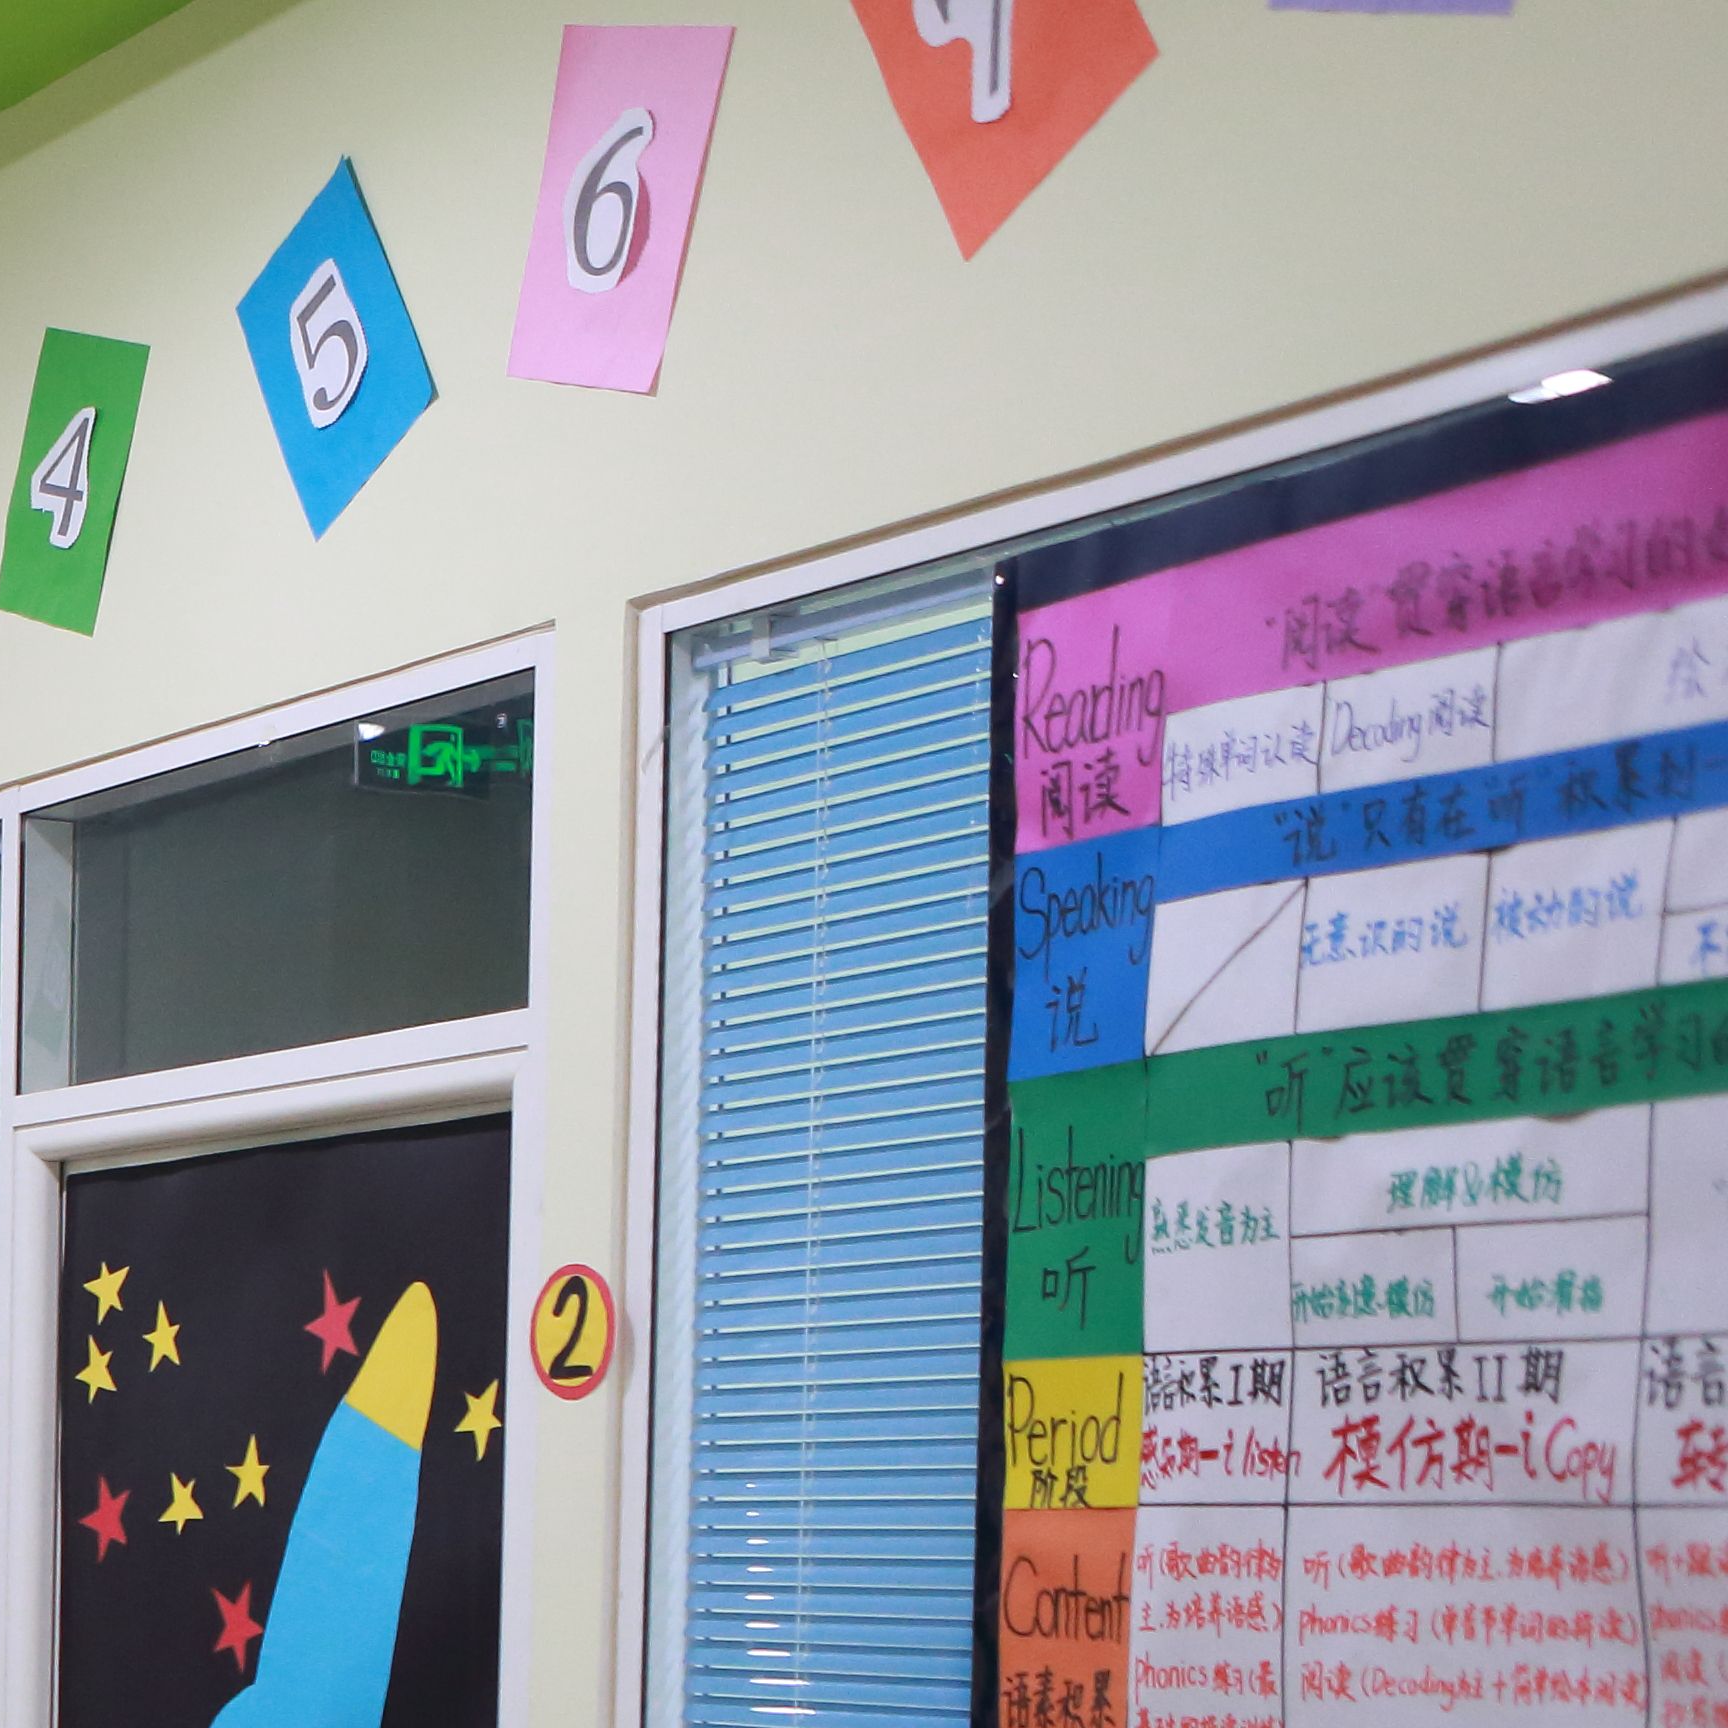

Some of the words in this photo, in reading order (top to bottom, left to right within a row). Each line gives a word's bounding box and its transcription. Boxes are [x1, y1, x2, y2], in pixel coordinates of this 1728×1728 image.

[574, 126, 643, 276] 6
[297, 277, 360, 412] 5
[38, 417, 92, 538] 4
[1022, 624, 1164, 767] Reading
[1041, 748, 1129, 839] 阅读
[1018, 853, 1157, 966] Speaking
[1046, 966, 1098, 1053] 说
[1013, 1127, 1145, 1265] Listening
[549, 1276, 593, 1379] 2
[1043, 1247, 1096, 1329] 听
[1007, 1372, 1124, 1467] Period
[1028, 1466, 1091, 1509] 阶段
[1005, 1554, 1129, 1644] Content
